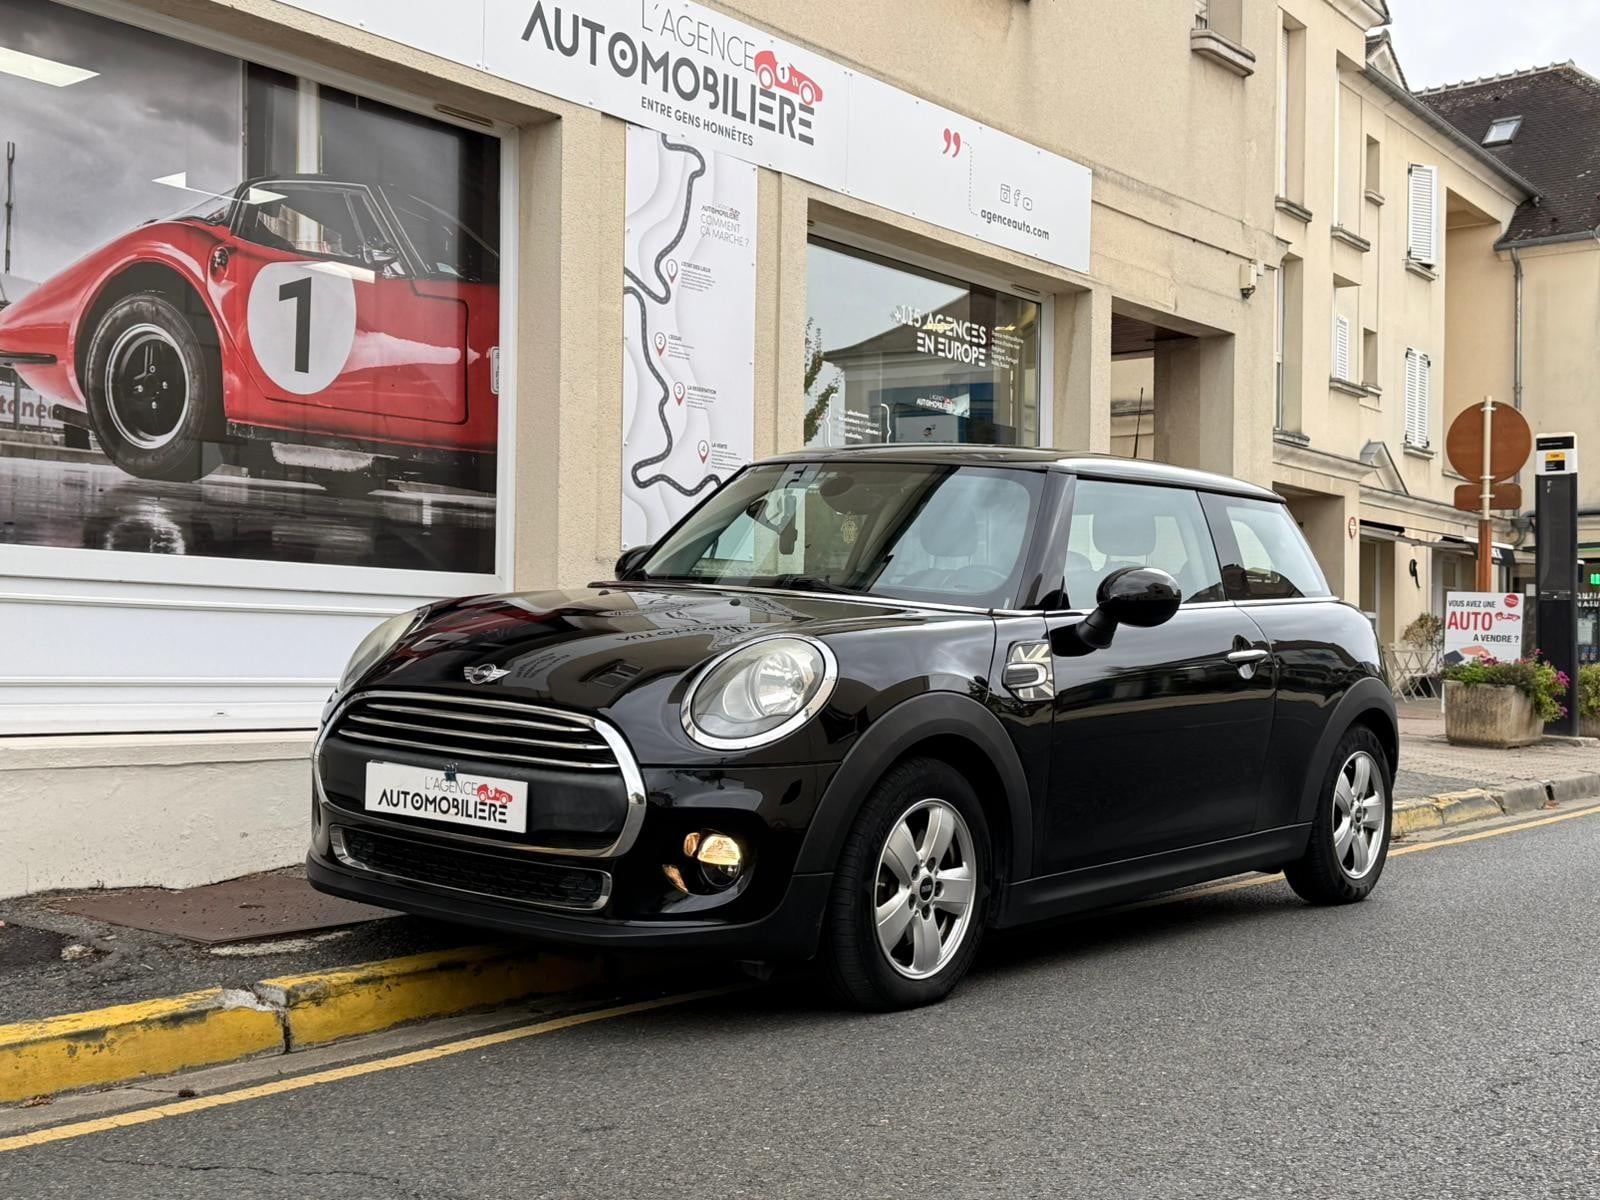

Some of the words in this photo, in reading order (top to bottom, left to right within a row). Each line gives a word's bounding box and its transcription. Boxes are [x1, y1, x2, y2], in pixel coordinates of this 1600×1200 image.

[641, 0, 756, 73] L'AGENCE
[641, 96, 672, 118] ENTRE
[674, 109, 701, 128] GENS
[703, 119, 754, 146] HONNÊTES
[700, 213, 740, 233] COMMENT
[980, 209, 1050, 240] agenceauto.com
[278, 276, 313, 374] 1
[925, 312, 987, 345] AGENCES
[917, 332, 935, 354] EN
[938, 337, 986, 367] EUROPE
[1448, 600, 1465, 608] VOUS
[1466, 600, 1482, 608] AVEZ
[1483, 600, 1496, 608] UNE
[1447, 610, 1493, 631] AUTO
[1481, 634, 1513, 643] VENDRE
[425, 775, 478, 796] L'AGENCE
